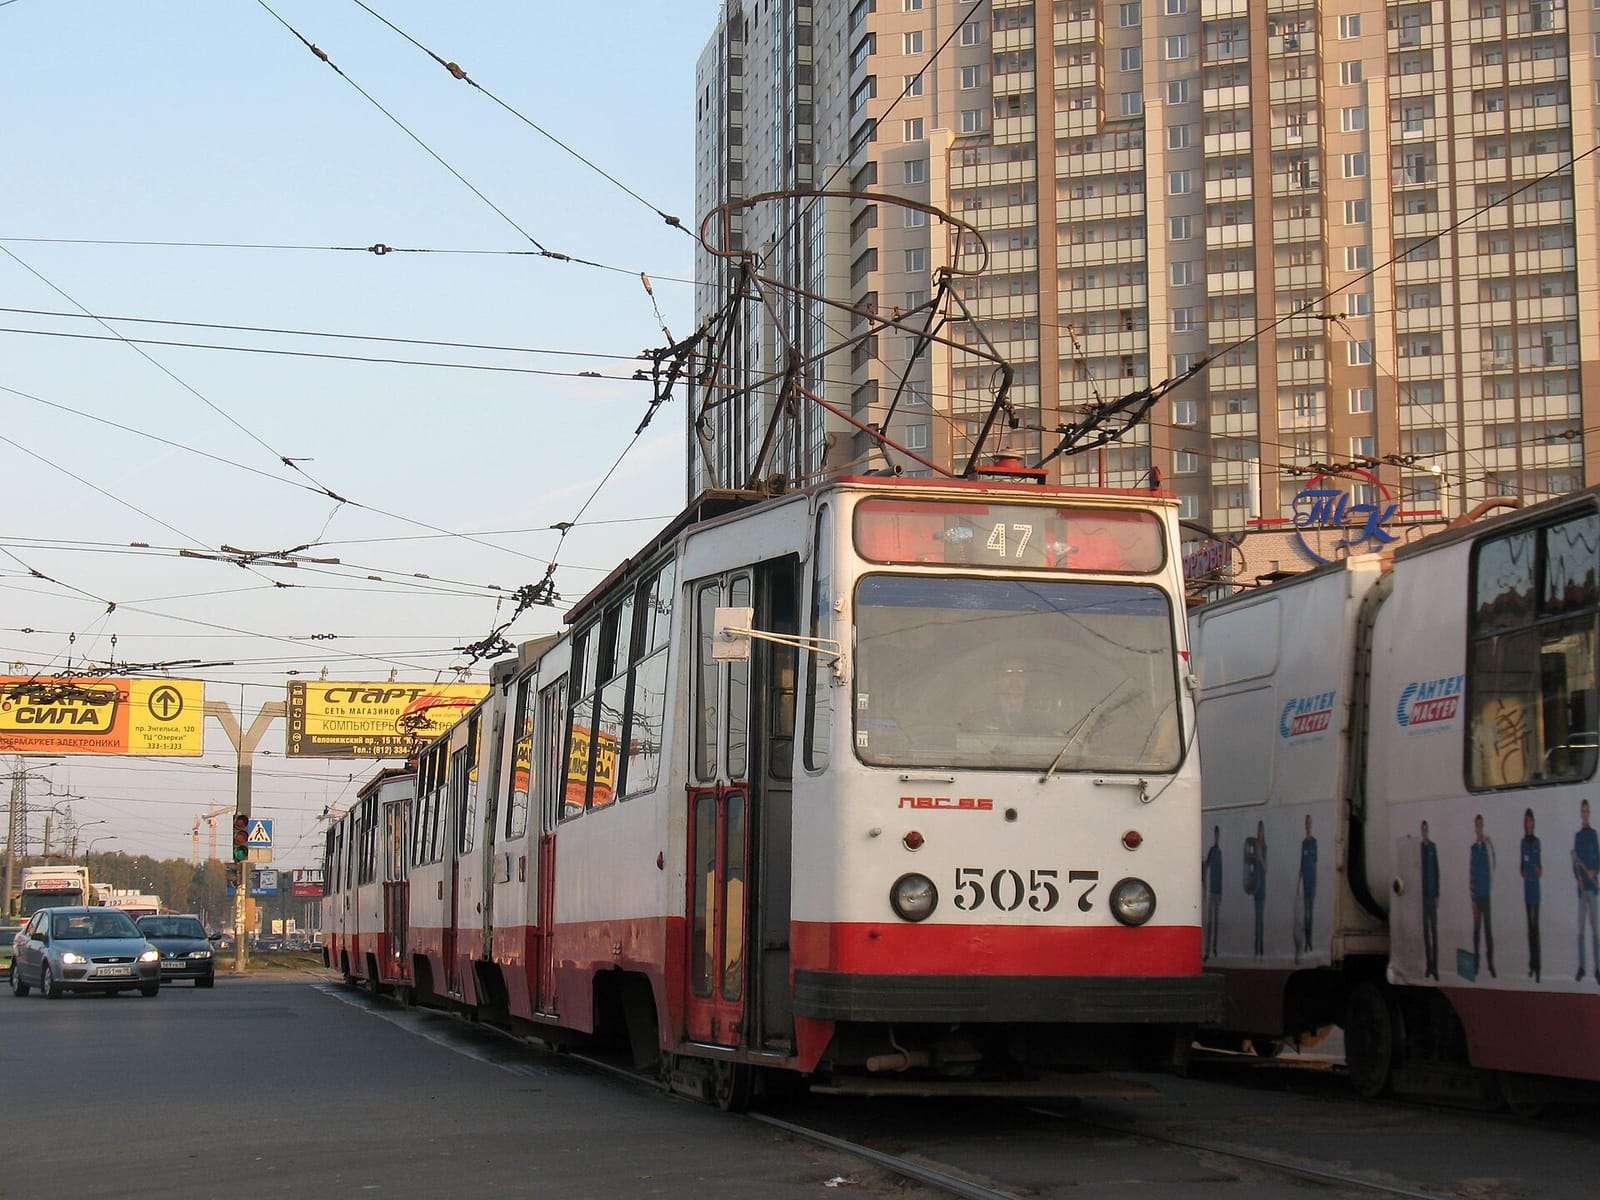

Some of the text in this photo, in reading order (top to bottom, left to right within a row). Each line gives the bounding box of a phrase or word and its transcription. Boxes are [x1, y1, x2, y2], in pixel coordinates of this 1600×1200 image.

[986, 523, 1033, 558] 47
[16, 707, 99, 725] СИЛА
[1411, 699, 1458, 722] МАСТЕР
[1293, 713, 1331, 734] МАСТЕР
[57, 739, 120, 748] ЭЛЕКТРОНИКИ
[312, 736, 363, 744] Коломяжский
[382, 736, 391, 744] 15
[954, 868, 1099, 913] 5057
